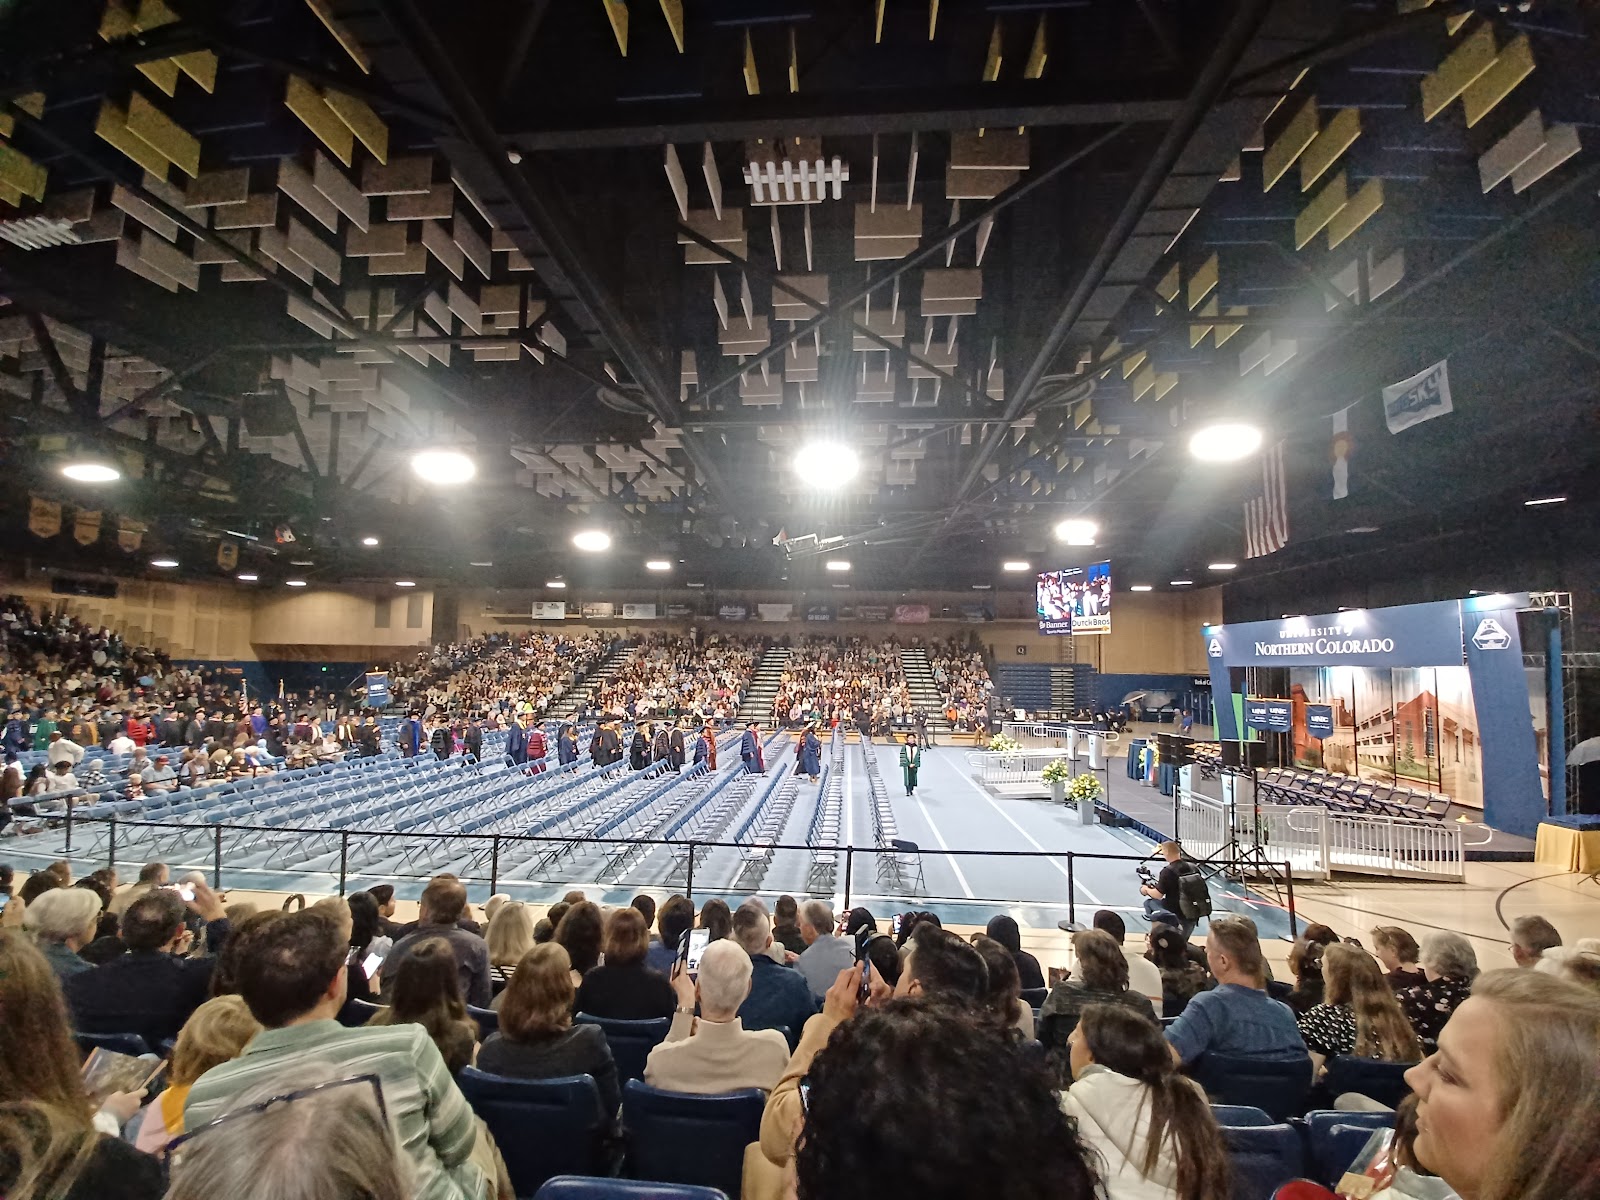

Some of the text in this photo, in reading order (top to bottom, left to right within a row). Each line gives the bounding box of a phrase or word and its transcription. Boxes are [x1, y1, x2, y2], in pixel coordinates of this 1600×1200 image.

[1046, 621, 1069, 629] Banner
[1254, 638, 1394, 656] NORTHERN COLORADO
